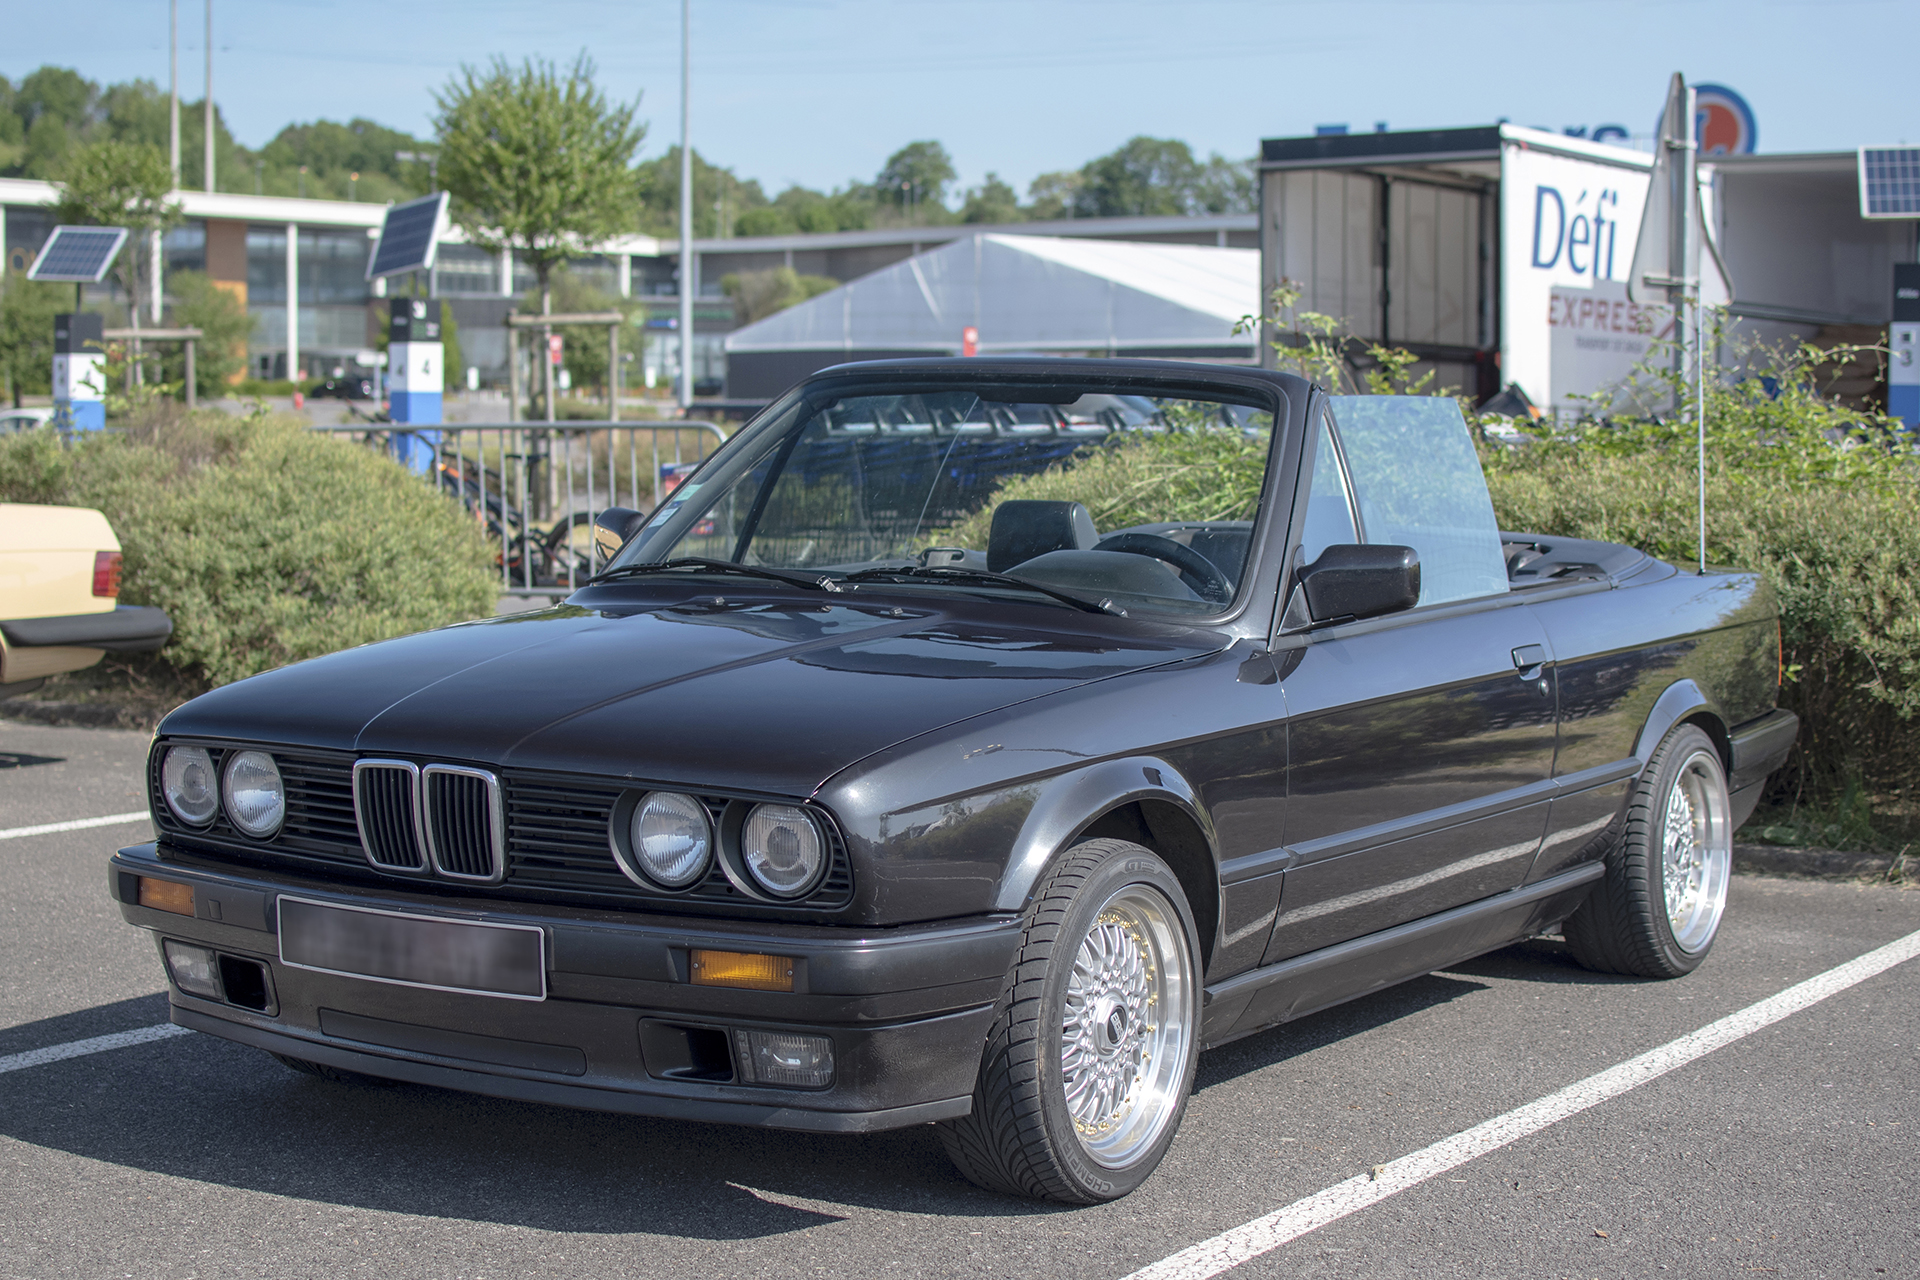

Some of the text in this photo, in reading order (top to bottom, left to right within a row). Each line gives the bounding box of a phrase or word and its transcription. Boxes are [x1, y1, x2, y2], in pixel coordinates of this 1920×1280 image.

[1531, 184, 1618, 280] Défi
[1547, 294, 1655, 335] EXPRESS
[1110, 1011, 1124, 1041] BBS
[1057, 1127, 1111, 1194] CHAMPIRO
